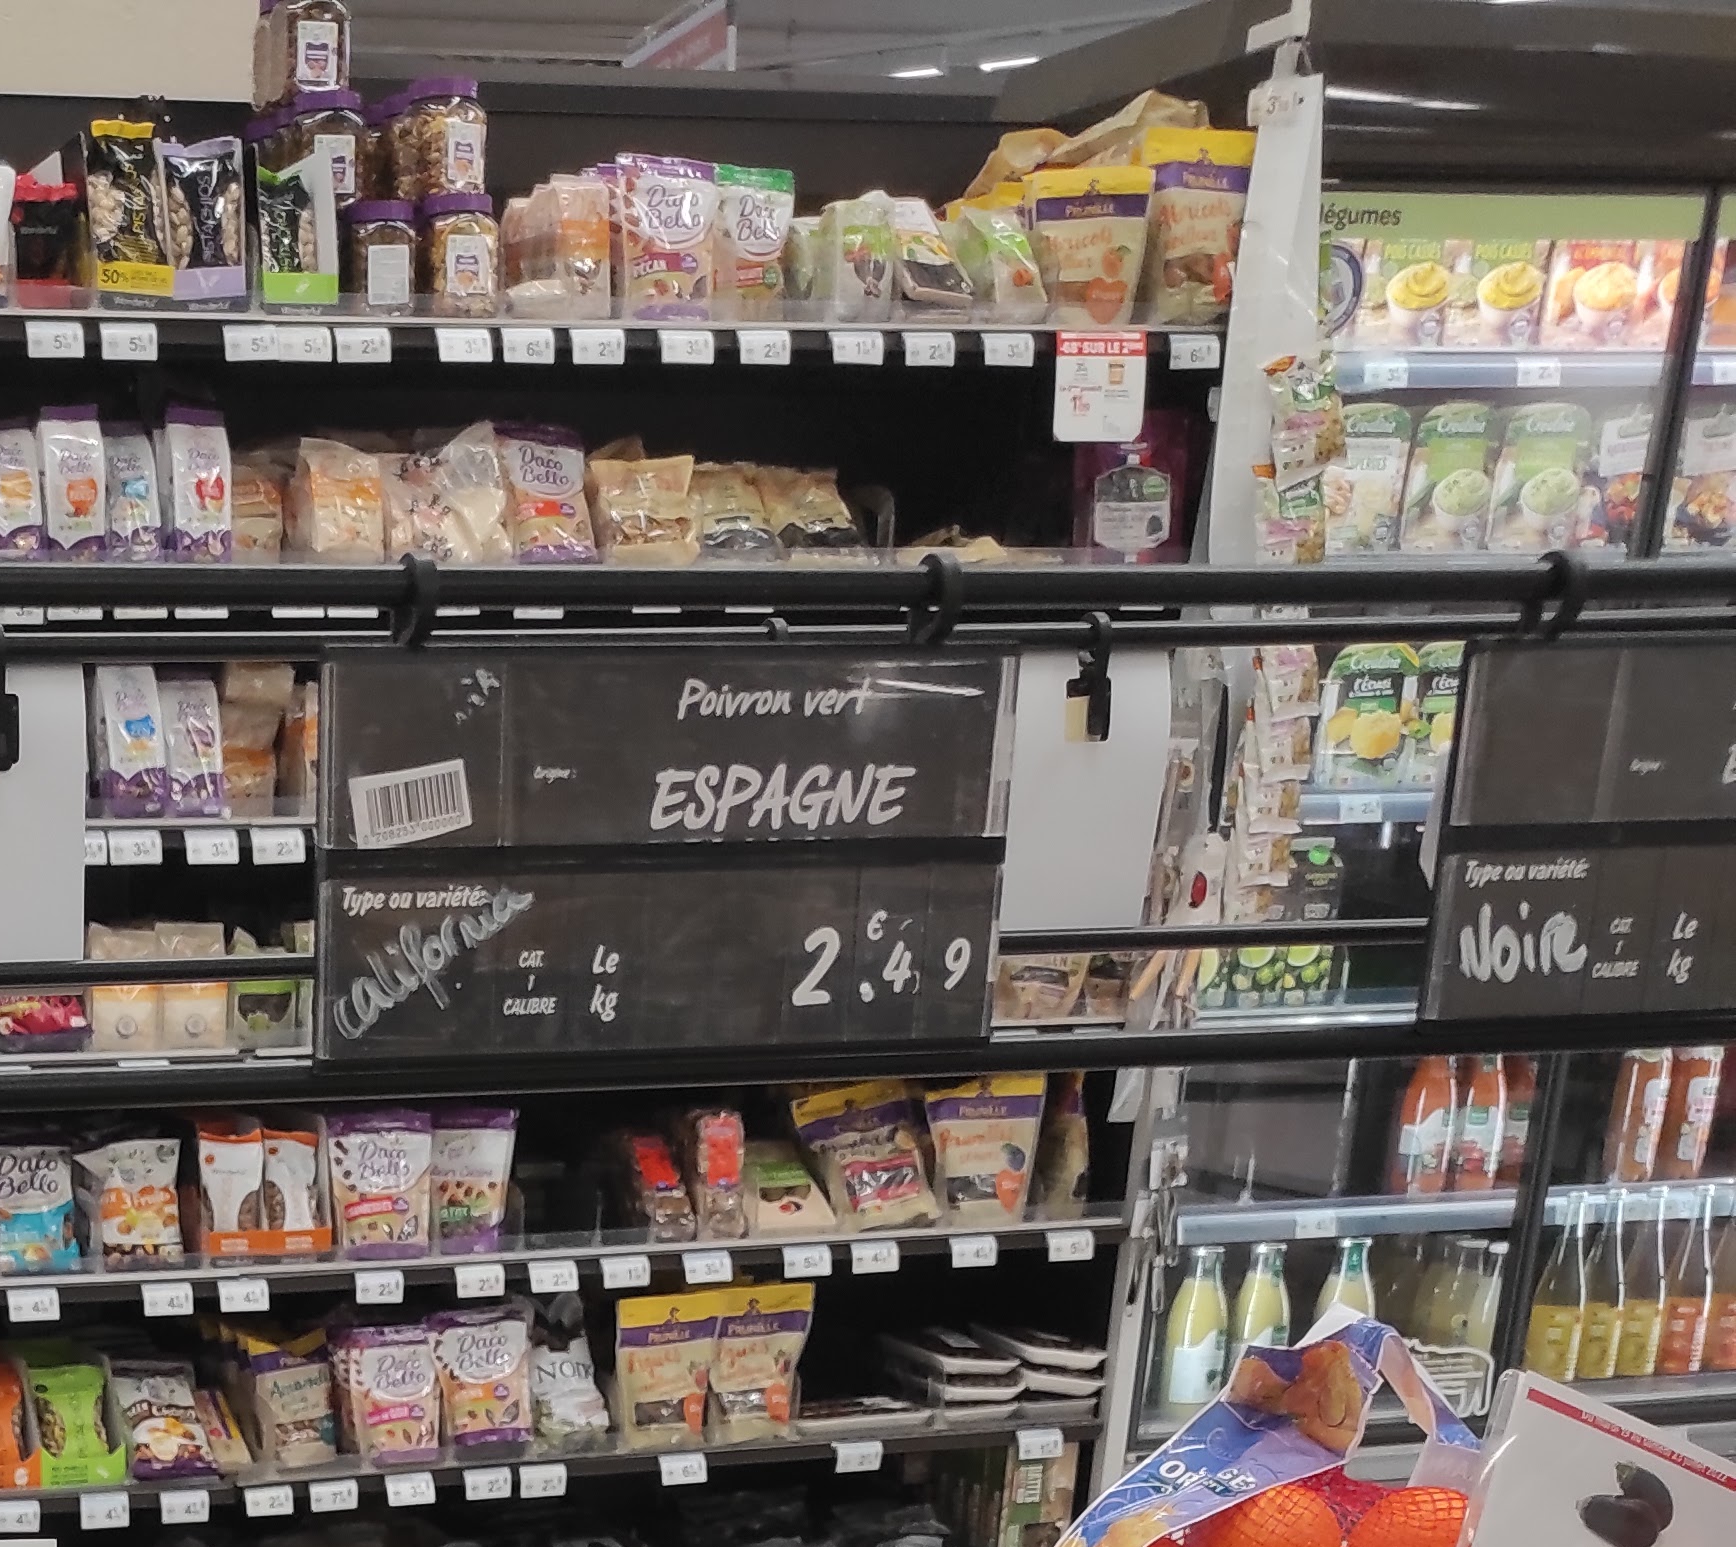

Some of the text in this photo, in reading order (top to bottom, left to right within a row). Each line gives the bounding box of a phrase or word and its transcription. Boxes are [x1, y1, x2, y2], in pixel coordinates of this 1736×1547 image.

[1319, 203, 1401, 230] légumes
[676, 675, 870, 721] Poivron vert
[649, 763, 917, 833] ESPAGNE
[1463, 858, 1501, 889] Type
[341, 886, 385, 917] Type
[388, 890, 411, 910] ou
[1671, 911, 1700, 942] Le
[591, 944, 620, 976] Le
[1666, 948, 1694, 985] kg
[502, 996, 558, 1016] CALIBRE
[588, 983, 620, 1022] kg
